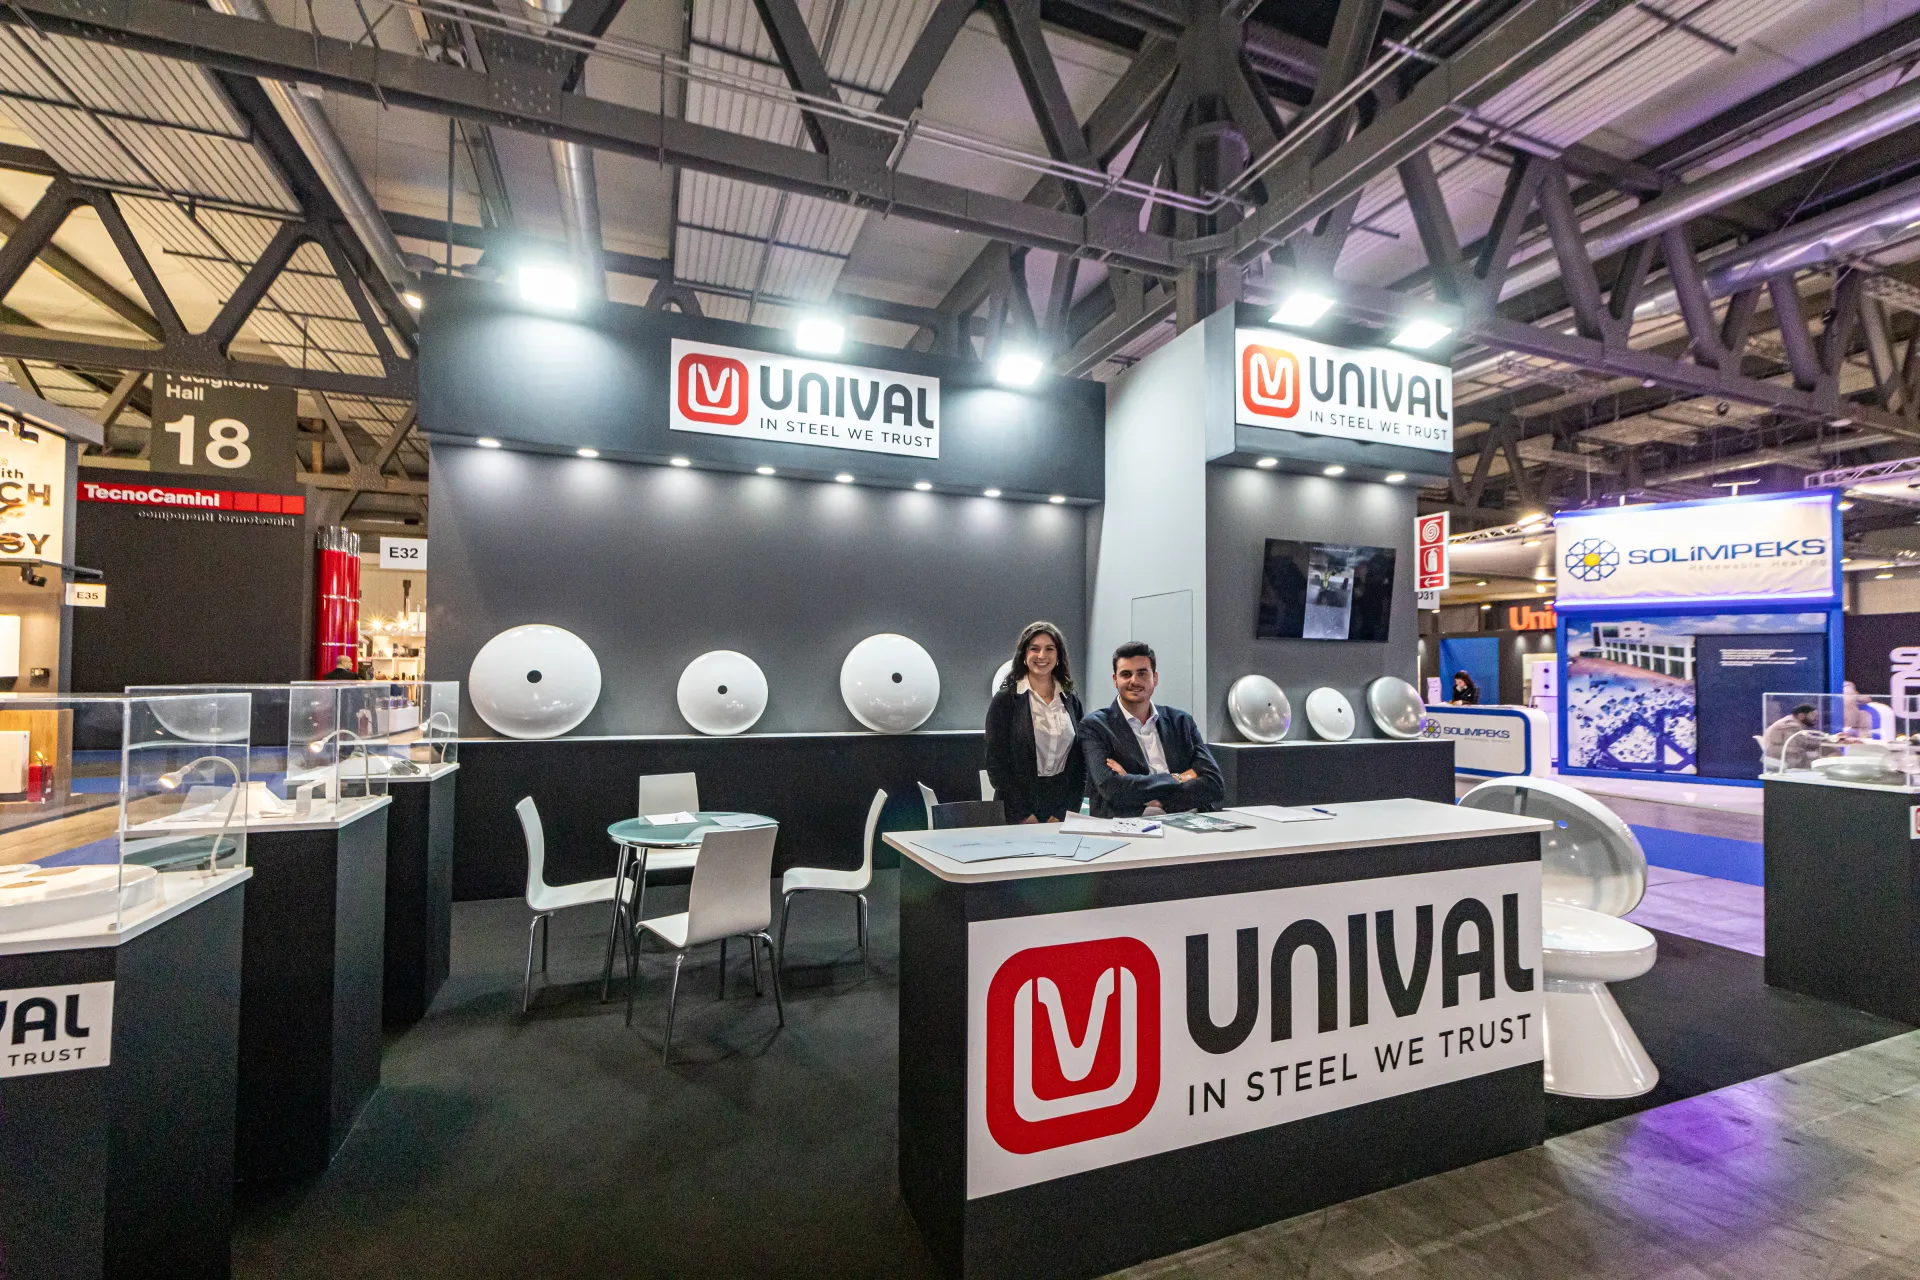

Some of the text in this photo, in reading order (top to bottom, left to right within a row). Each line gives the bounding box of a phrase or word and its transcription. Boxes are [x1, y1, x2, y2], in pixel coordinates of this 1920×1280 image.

[166, 384, 204, 401] Hall
[760, 418, 933, 448] IN STEEL WE TRUST
[1310, 411, 1449, 441] IN STEEL WE TRUST
[164, 414, 252, 469] 18
[84, 484, 220, 507] TecnoCamini
[389, 546, 419, 559] E32
[76, 591, 99, 600] E35
[7, 1047, 87, 1067] TRUST
[1188, 1013, 1532, 1116] IN STEEL WE TRUST
